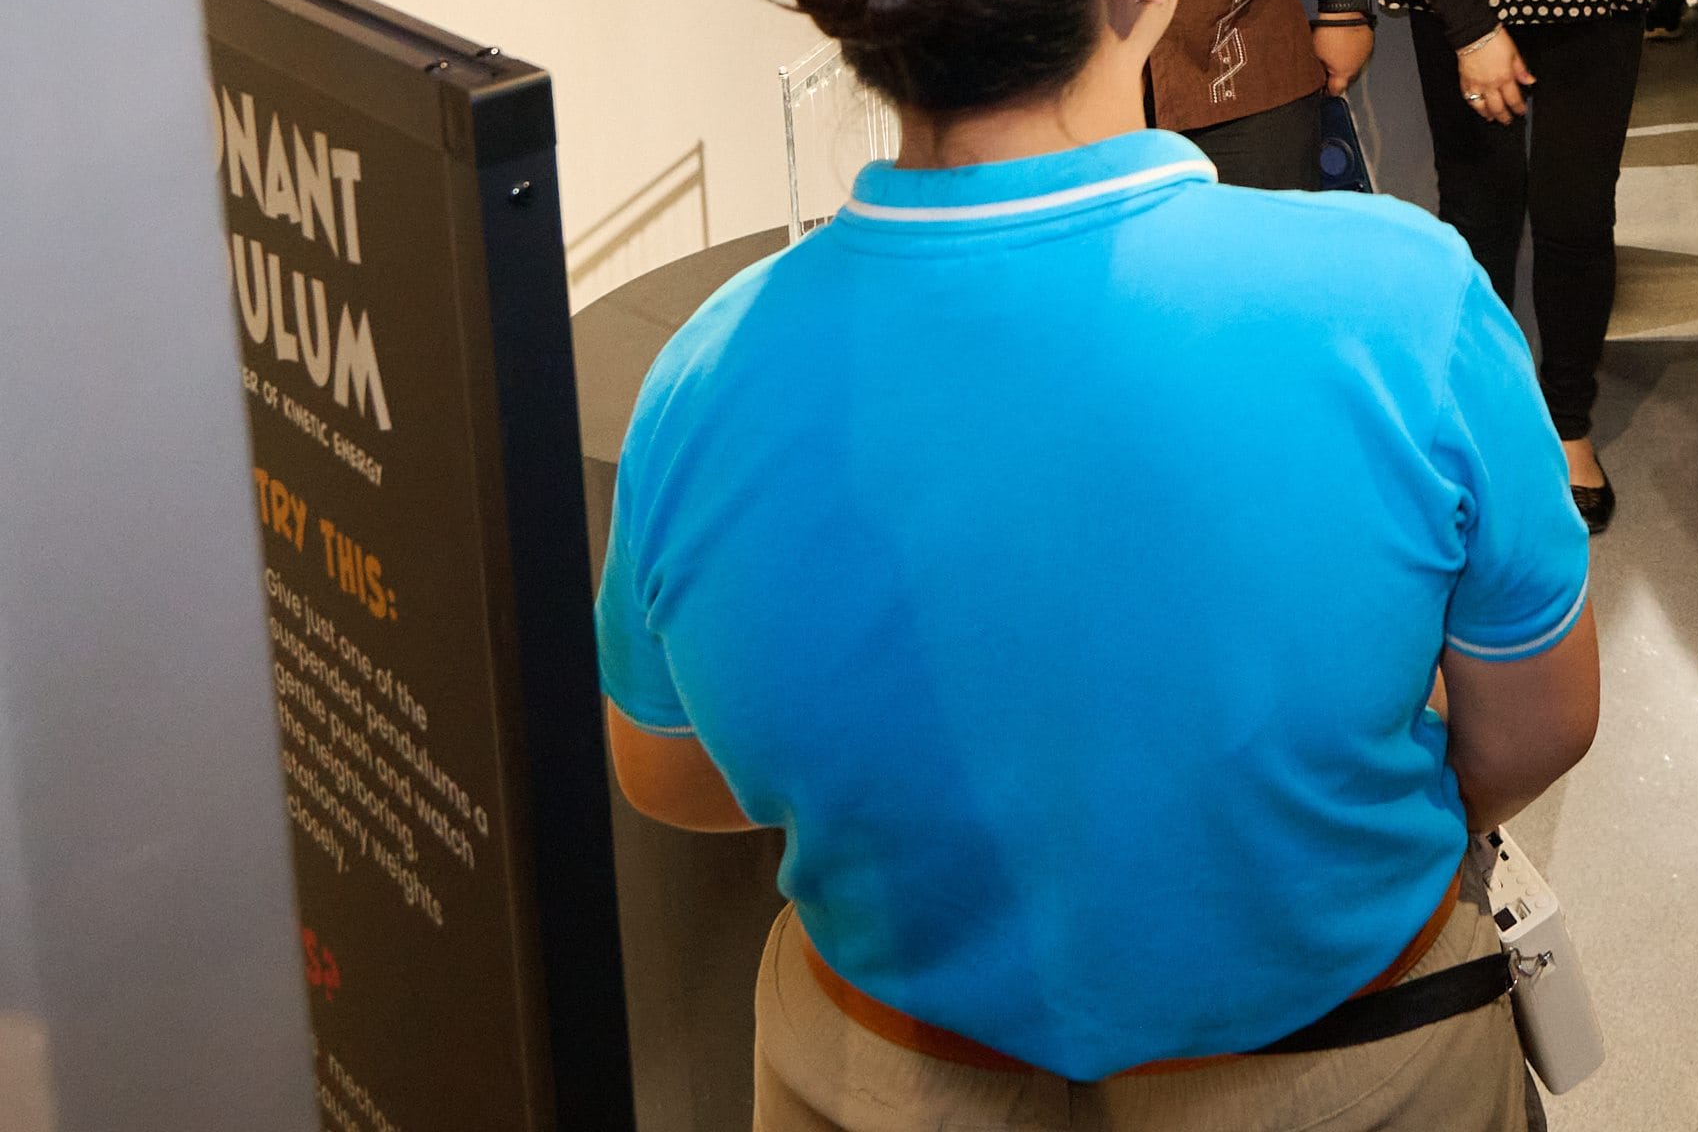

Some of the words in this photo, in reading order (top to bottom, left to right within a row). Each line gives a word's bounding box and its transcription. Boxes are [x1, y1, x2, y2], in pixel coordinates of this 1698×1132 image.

[211, 84, 362, 265] NANT
[262, 380, 279, 410] OF
[282, 393, 330, 448] KINETIC
[333, 431, 383, 487] ENERGY
[253, 467, 308, 554] TRY
[319, 518, 399, 621] THIS:
[266, 568, 302, 618] Give
[305, 596, 337, 651] just
[339, 636, 372, 681] one
[376, 669, 393, 703] of
[396, 681, 428, 731] the
[270, 617, 363, 716] suspended
[366, 701, 472, 819] pendulums
[474, 805, 488, 837] a
[278, 699, 306, 746] the
[275, 661, 326, 724] gentle
[330, 711, 373, 769] push
[375, 756, 413, 807] and
[413, 791, 475, 870] watch
[282, 750, 368, 856] stationary
[371, 834, 443, 926] weights
[287, 793, 350, 874] closely.
